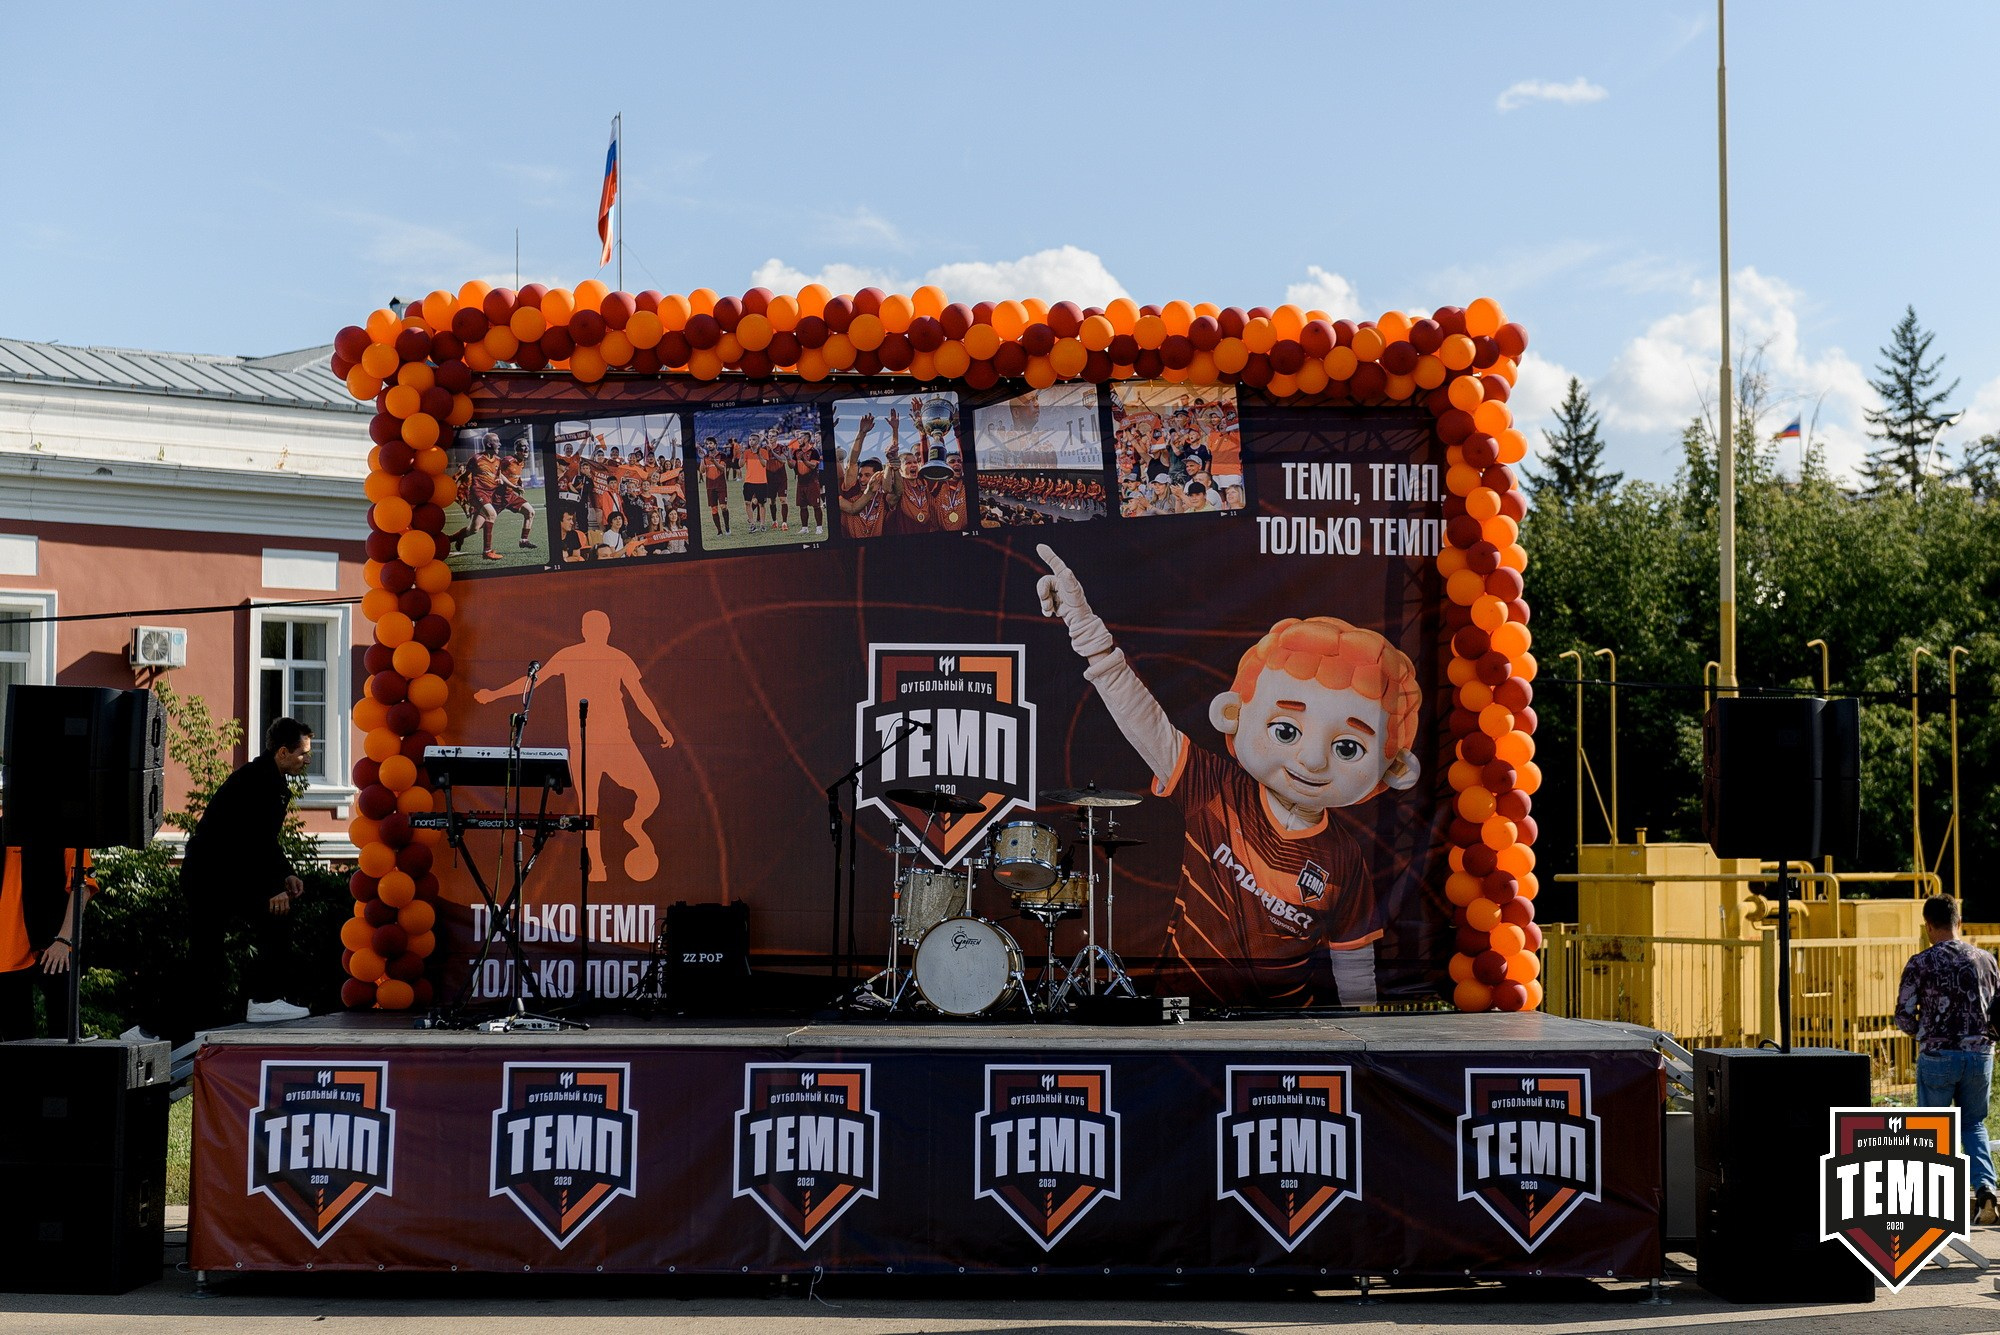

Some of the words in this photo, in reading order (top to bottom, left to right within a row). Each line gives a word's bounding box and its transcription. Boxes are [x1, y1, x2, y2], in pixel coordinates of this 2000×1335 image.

[1282, 462, 1361, 506] ТЕМП,
[1256, 516, 1362, 555] ТОЛЬКО
[901, 678, 964, 694] ФУТБОЛЬНЫЙ
[967, 681, 993, 695] КЛУБ
[875, 708, 1018, 786] ТЕМП
[415, 819, 436, 827] nord
[1300, 871, 1325, 897] ТЕМП
[470, 903, 577, 943] ТОЬКО
[683, 953, 697, 963] ZZ
[699, 952, 724, 963] POP
[286, 1089, 338, 1102] ФУТБОЛЬНЫЙ
[340, 1091, 361, 1104] КЛУБ
[528, 1090, 580, 1103] ФУТБОЛЬНЫЙ
[582, 1092, 603, 1104] КЛУБ
[771, 1091, 822, 1104] ФУТБОЛЬНЫЙ
[824, 1093, 844, 1105] КЛУБ
[1011, 1092, 1062, 1105] ФУТБОЛЬНЫЙ
[1064, 1094, 1085, 1106] КЛУБ
[1252, 1093, 1303, 1106] ФУТБОЛЬНЫЙ
[1305, 1095, 1326, 1107] КЛУБ
[1491, 1097, 1543, 1109] ФУТБОЛЬНЫЙ
[1545, 1099, 1566, 1110] КЛУБ
[265, 1114, 380, 1176] ТЕМП
[507, 1115, 623, 1178] ТЕМП
[750, 1115, 864, 1178] ТЕМП
[991, 1117, 1105, 1179] ТЕМП
[1232, 1118, 1346, 1180] ТЕМП
[1472, 1121, 1586, 1183] ТЕМП
[311, 1175, 329, 1184] 2020
[554, 1176, 572, 1186] 2020
[797, 1177, 815, 1187] 2020
[1039, 1178, 1056, 1188] 2020
[1280, 1179, 1298, 1189] 2020
[1520, 1180, 1538, 1190] 2020
